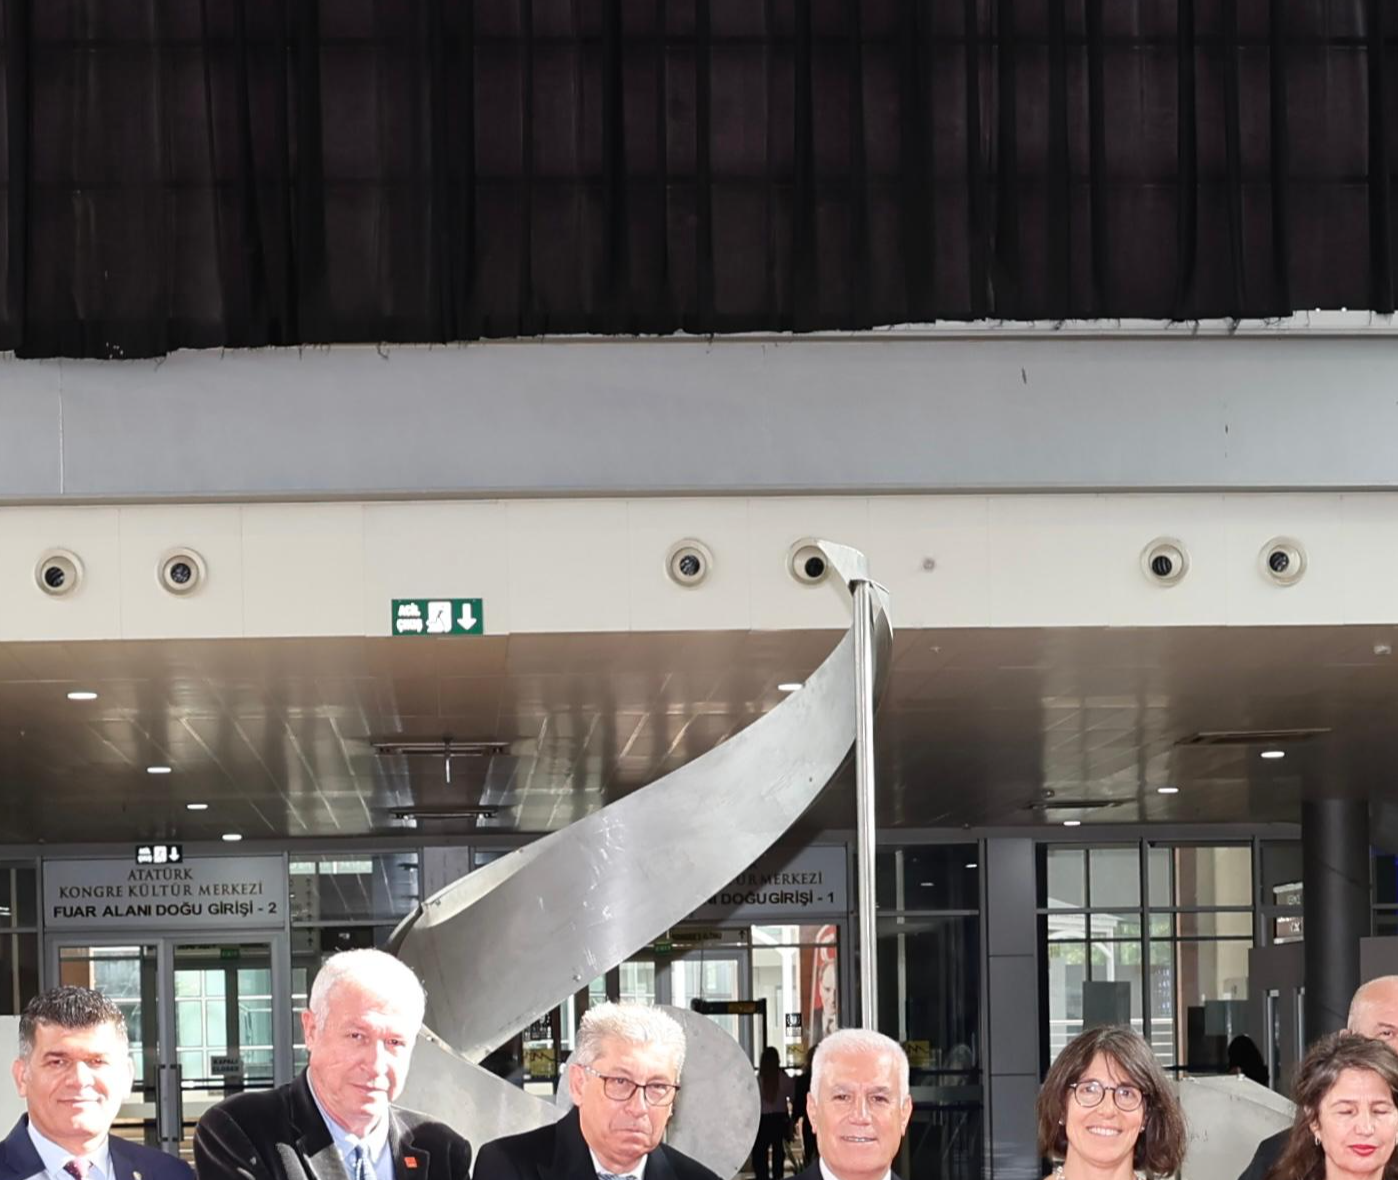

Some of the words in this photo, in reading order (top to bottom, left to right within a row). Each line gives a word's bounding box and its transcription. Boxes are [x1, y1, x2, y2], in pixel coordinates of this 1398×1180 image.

[127, 867, 194, 882] ATATÜRK
[761, 871, 823, 886] MERKEZİ
[59, 885, 123, 899] KONGRE
[128, 882, 193, 898] KÜLTÜR
[198, 881, 264, 896] MERKEZİ
[768, 889, 814, 907] GİRİŞİ
[827, 892, 834, 903] 1
[53, 904, 97, 918] FUAR
[102, 903, 152, 918] ALANI
[156, 900, 202, 917] DOĞU
[208, 899, 254, 918] GİRİŞİ
[268, 902, 277, 914] 2
